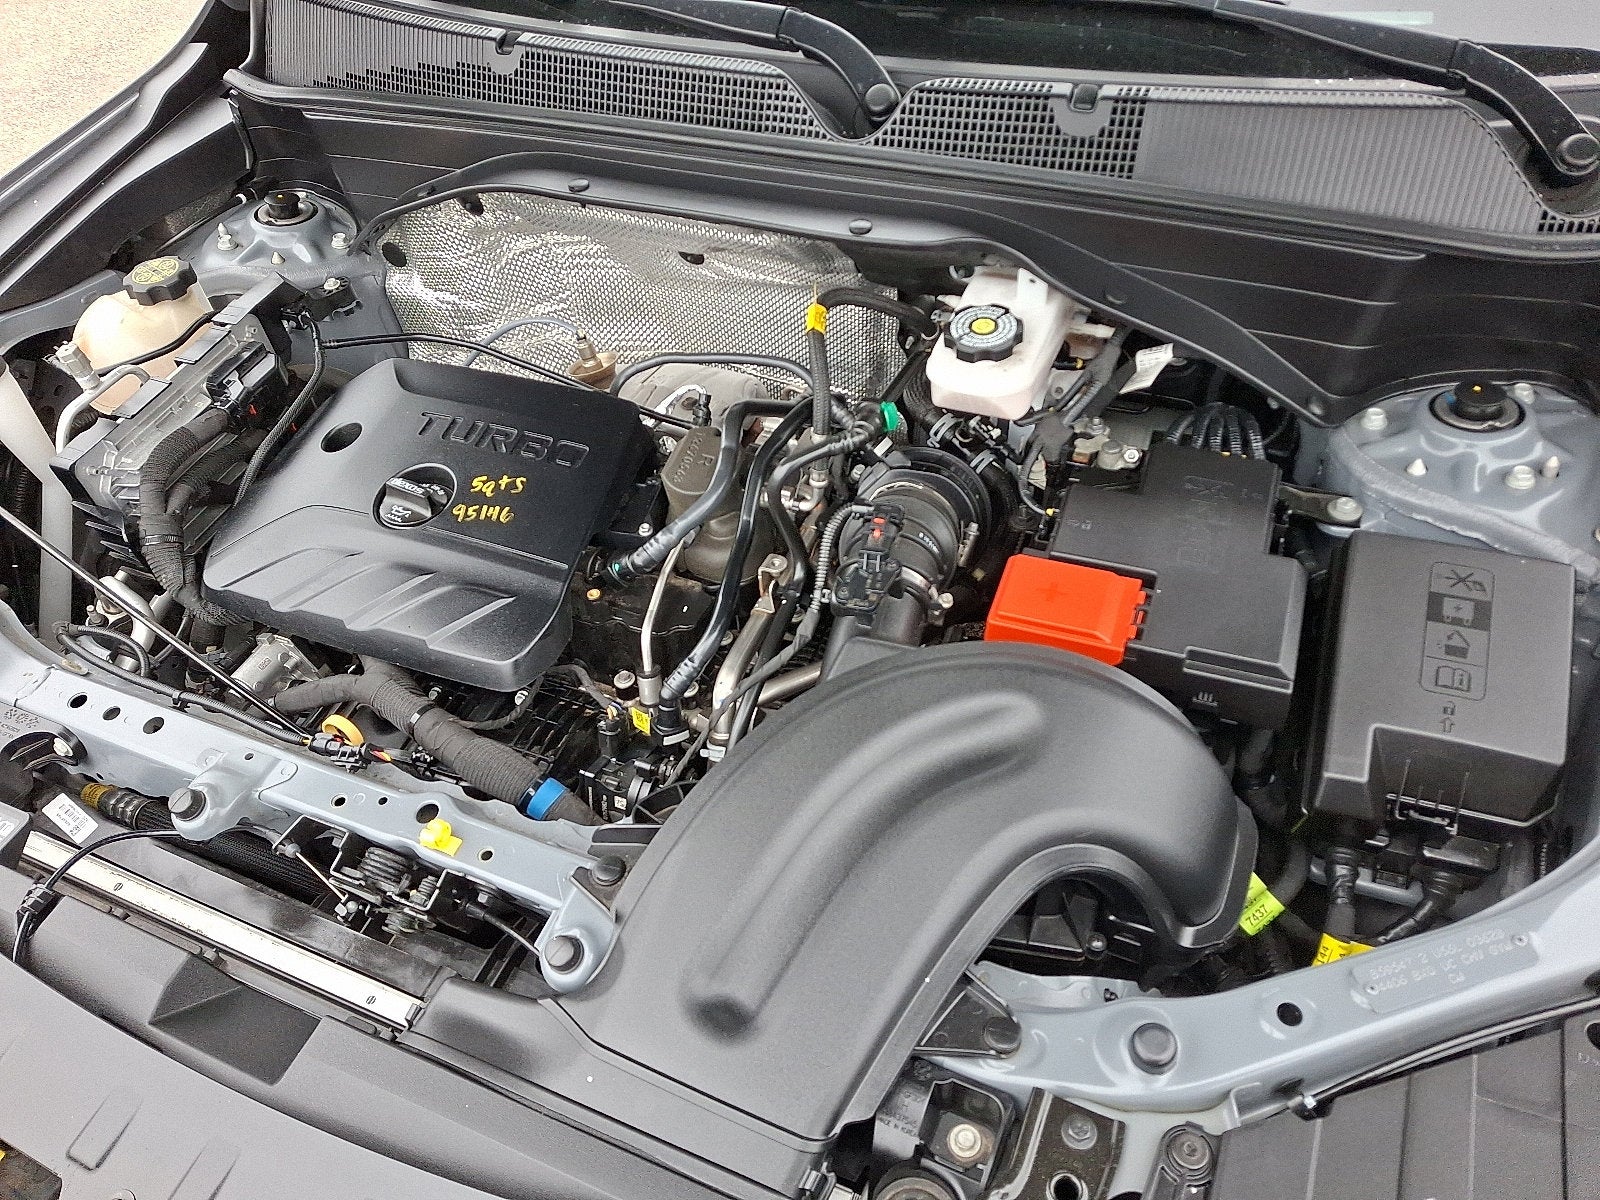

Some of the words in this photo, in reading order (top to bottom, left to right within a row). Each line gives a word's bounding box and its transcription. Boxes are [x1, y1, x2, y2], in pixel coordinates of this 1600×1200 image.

[418, 411, 590, 468] TURBO
[452, 503, 515, 524] 95146
[1245, 904, 1269, 926] 7437
